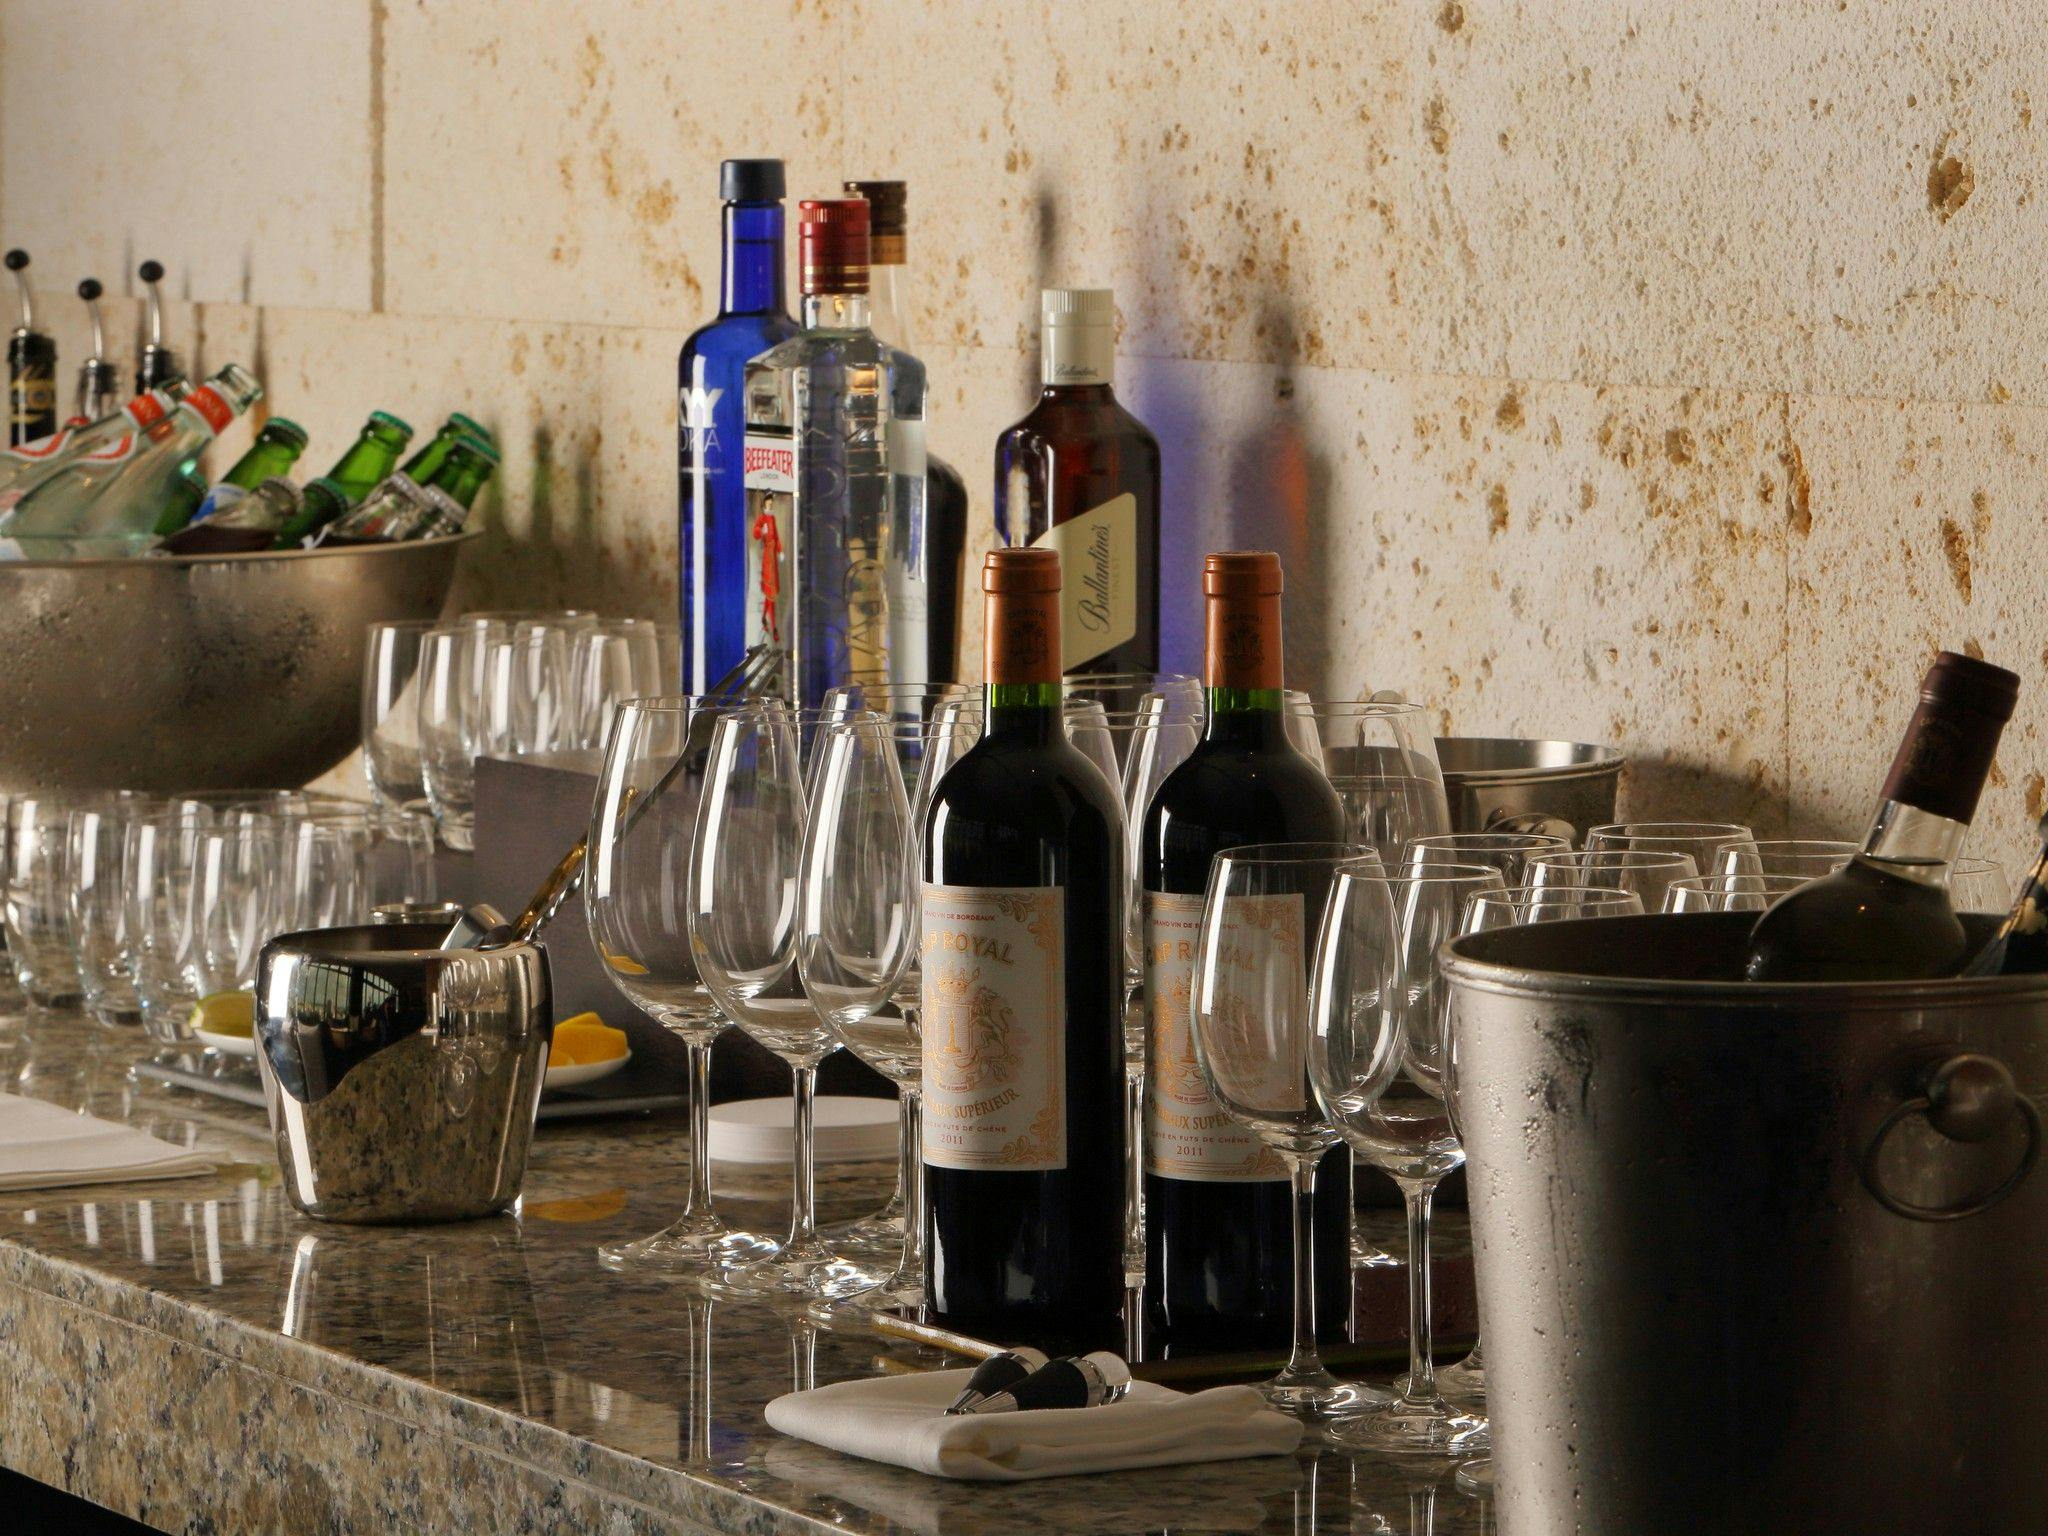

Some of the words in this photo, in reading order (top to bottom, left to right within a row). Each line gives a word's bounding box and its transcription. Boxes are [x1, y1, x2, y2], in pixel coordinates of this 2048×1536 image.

[745, 446, 794, 479] BEEFEATER
[1077, 523, 1111, 635] Ballantine's
[956, 913, 996, 922] BORDEAUX
[943, 930, 1014, 966] ROYAL
[954, 1087, 1021, 1120] SUPÉRIEUR
[939, 1134, 964, 1145] 2011
[962, 1125, 973, 1133] DE
[1175, 1145, 1202, 1156] 2011
